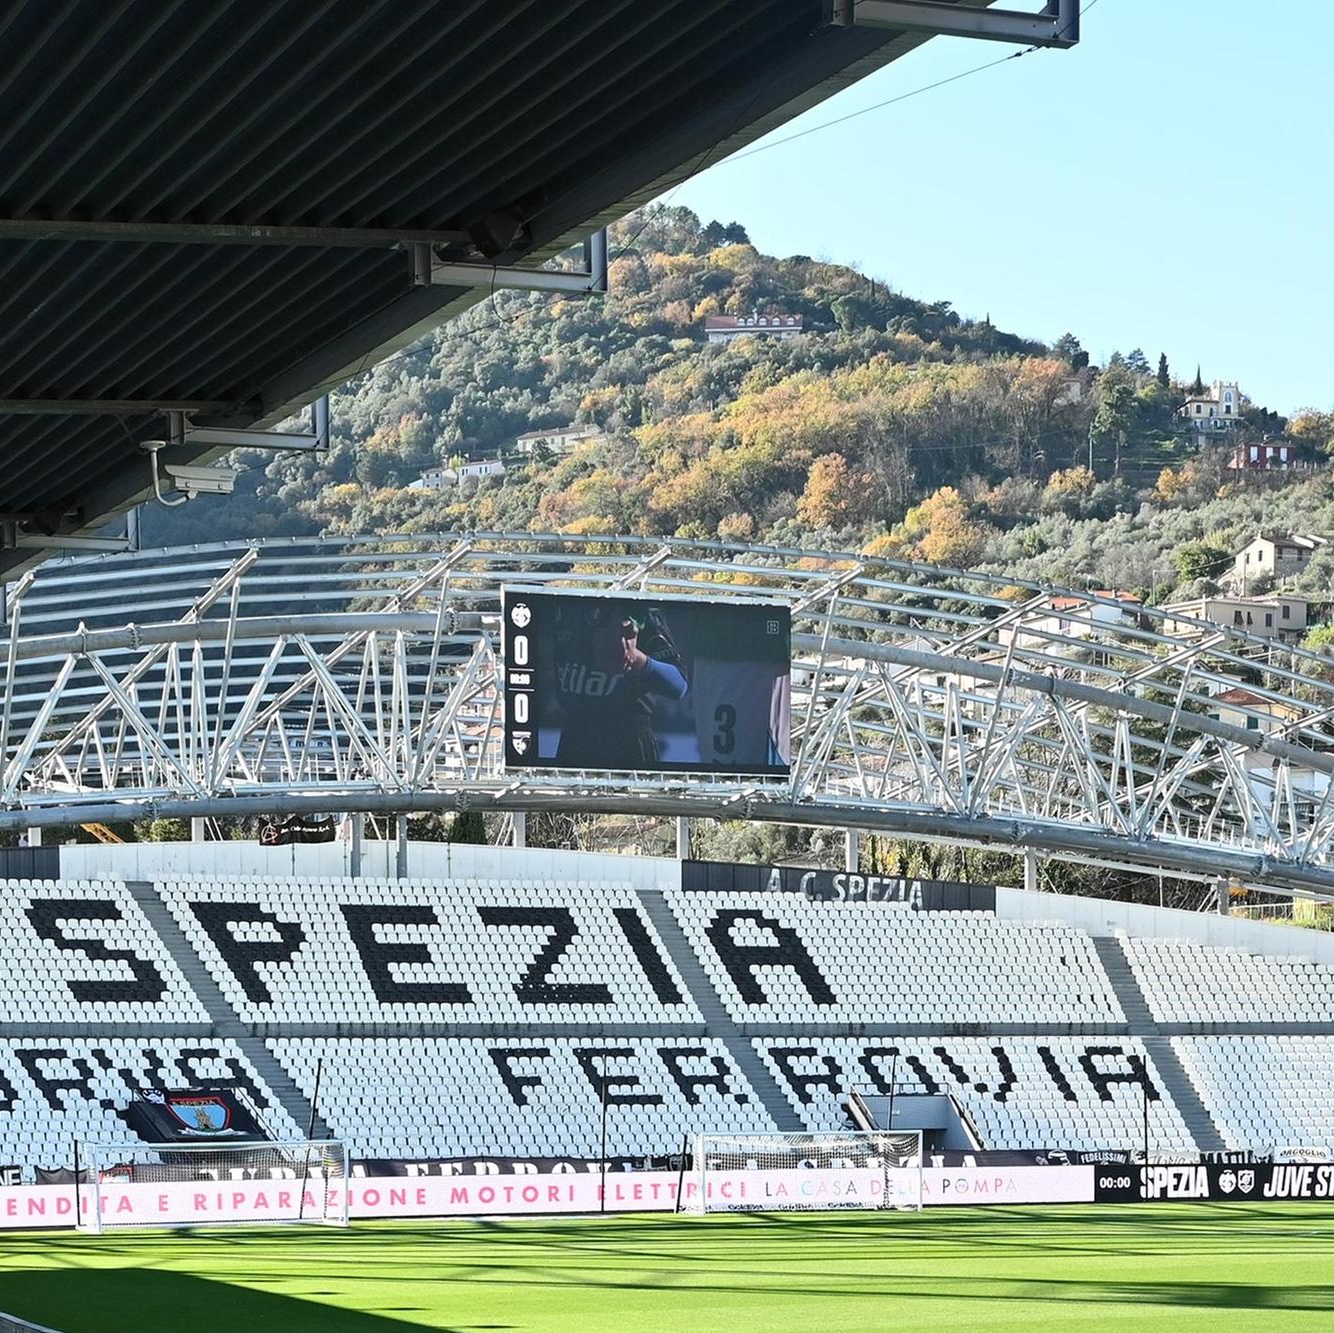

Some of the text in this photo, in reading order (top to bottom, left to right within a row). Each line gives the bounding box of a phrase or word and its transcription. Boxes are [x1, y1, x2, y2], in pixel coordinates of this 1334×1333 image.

[713, 703, 737, 755] 3
[831, 874, 924, 911] SPEZIA
[26, 897, 837, 1005] SPEZIA
[1080, 1152, 1127, 1164] FEDELISSIMI
[1279, 1147, 1327, 1158] ORGOGLIO
[158, 1194, 169, 1212] E
[194, 1188, 427, 1211] RIPARAZIONE
[450, 1184, 575, 1205] MOTORI
[597, 1182, 747, 1200] ELETTRICI
[765, 1181, 788, 1197] LA
[801, 1179, 857, 1196] CASA
[942, 1176, 1019, 1194] POMPA
[1099, 1176, 1132, 1189] 00:00
[1139, 1166, 1210, 1198] SPEZIA
[1263, 1166, 1312, 1197] JUVE
